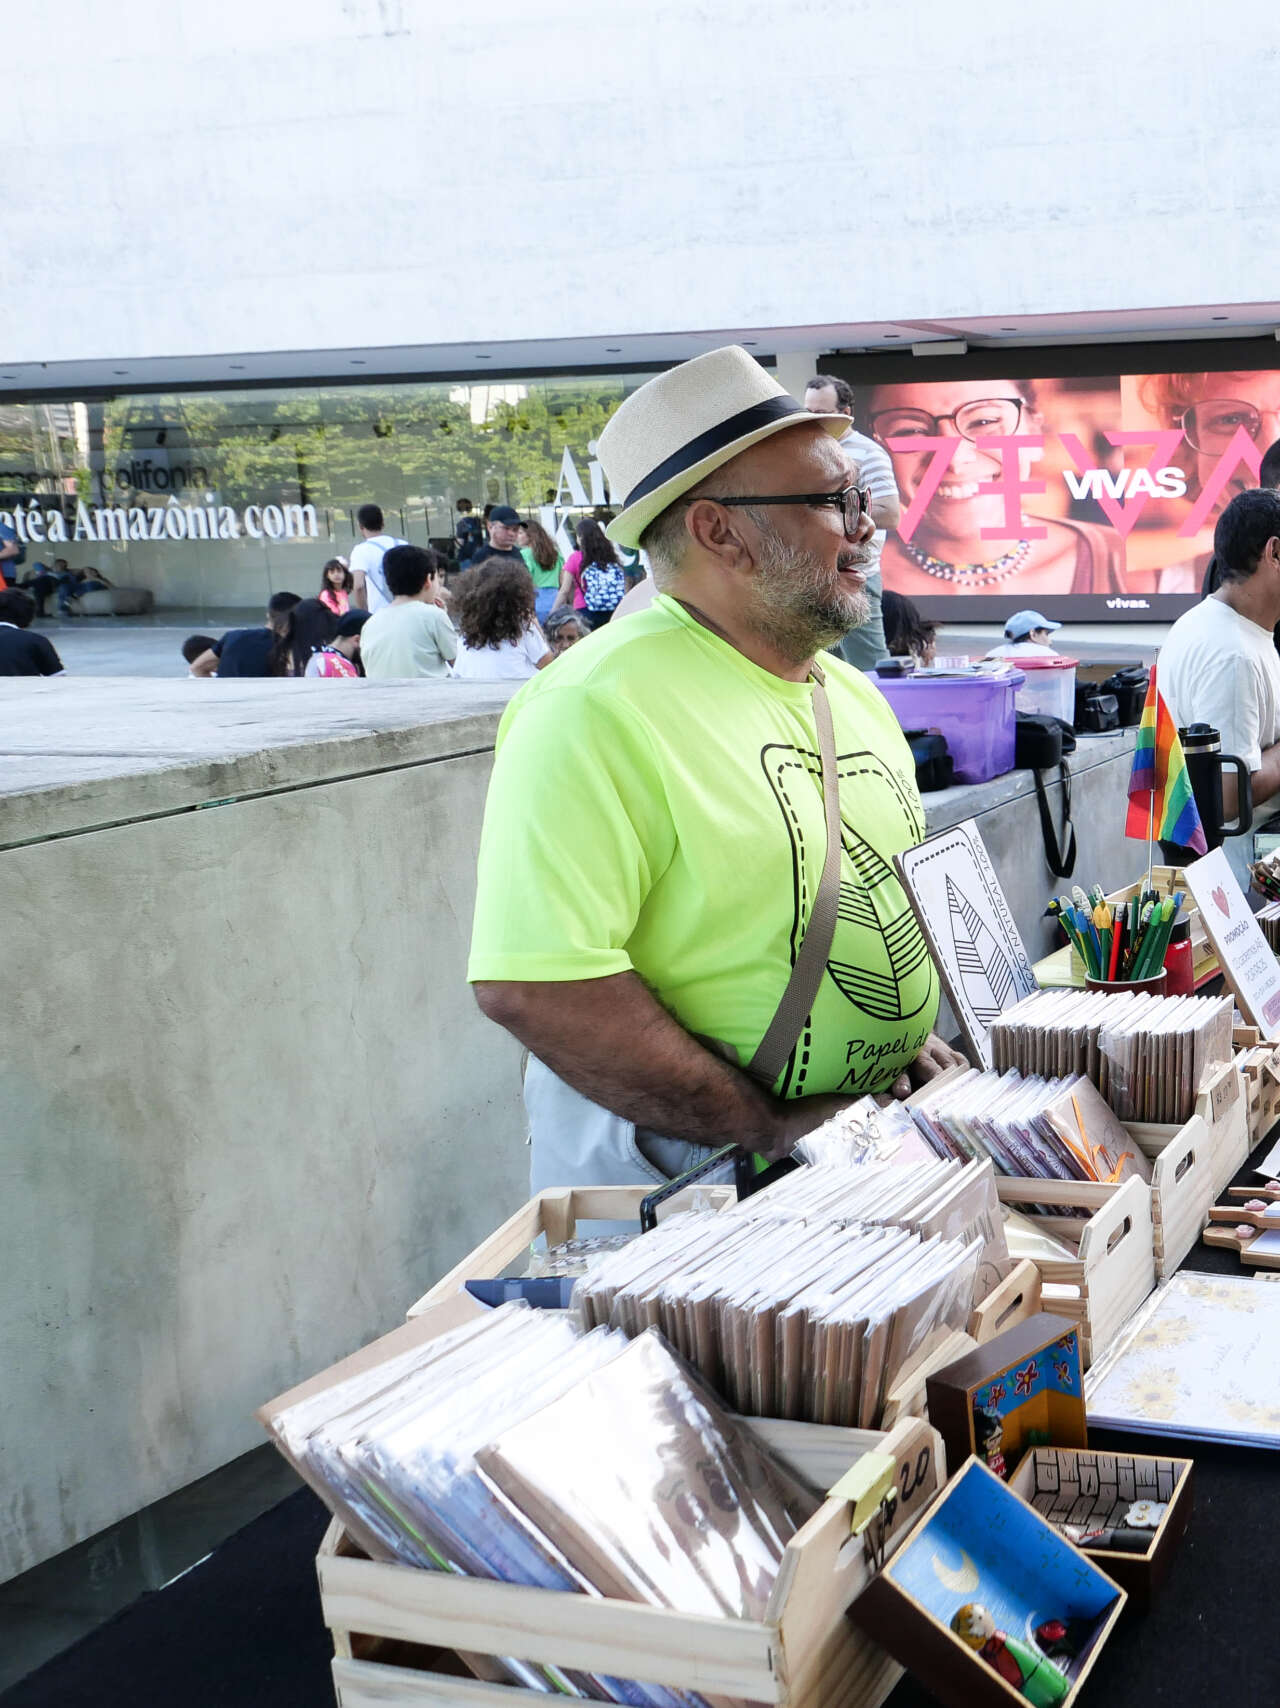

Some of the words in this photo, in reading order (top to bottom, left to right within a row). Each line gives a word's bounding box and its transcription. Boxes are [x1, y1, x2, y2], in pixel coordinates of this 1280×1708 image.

[97, 460, 211, 507] polifonia
[1062, 466, 1188, 500] VIVAS
[47, 510, 69, 542] a
[73, 493, 240, 542] Amazônia
[244, 503, 319, 539] com
[989, 880, 1021, 947] NATURAL
[1224, 919, 1250, 946] PROMOÇÃO
[846, 1031, 909, 1065] Papel
[901, 1445, 930, 1502] 20
